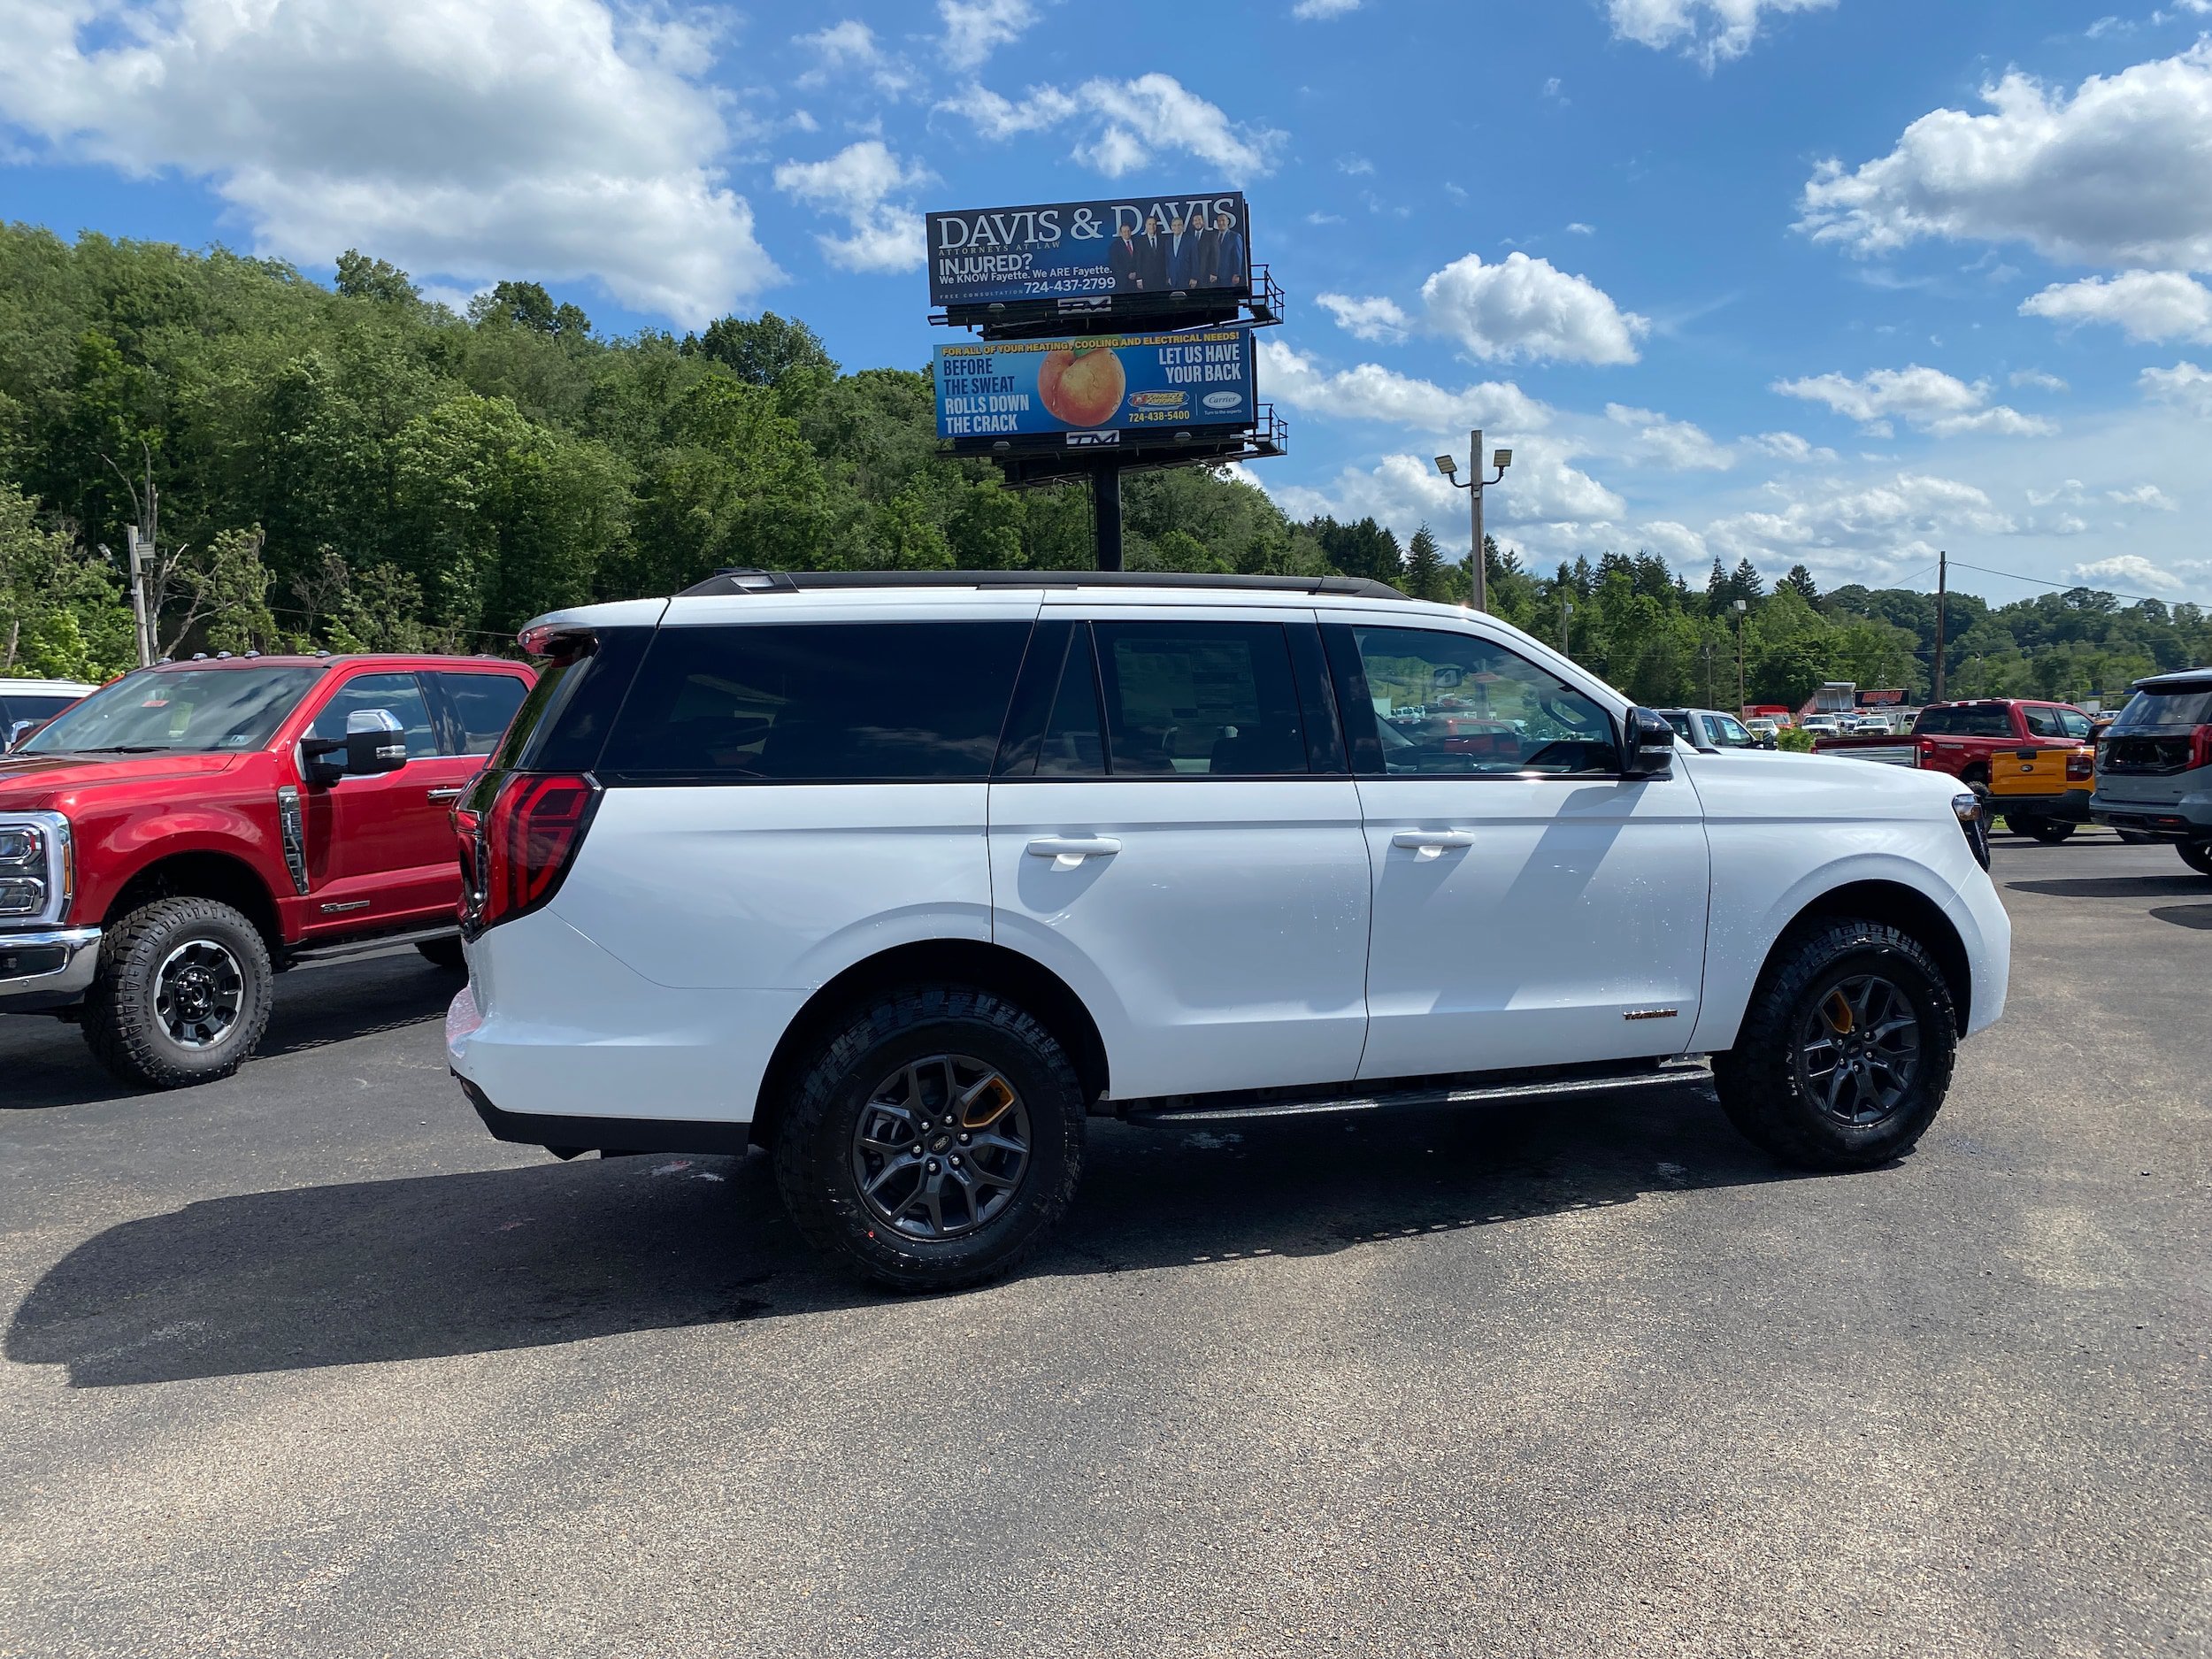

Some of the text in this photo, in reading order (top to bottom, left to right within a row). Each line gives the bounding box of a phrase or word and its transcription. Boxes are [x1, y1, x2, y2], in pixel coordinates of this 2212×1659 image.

[936, 197, 1236, 250] DAVIS & DAVIS
[939, 245, 1009, 257] ATTORNEYS
[1036, 242, 1060, 250] LAW
[939, 253, 1033, 275] INJURED?
[940, 265, 1113, 284] We KNOW Fayette. We ARE Fayette.
[1024, 276, 1116, 294] 724-437-2799
[942, 347, 963, 357] FOR
[964, 346, 982, 355] ALL
[983, 345, 997, 354] OF
[998, 343, 1026, 353] YOUR
[1074, 338, 1119, 349] COOLING
[1120, 336, 1141, 347] AND
[1143, 334, 1202, 345] ELECTRICAL
[1203, 331, 1240, 342] NEEDS!
[1158, 343, 1240, 365] LET US HAVE
[943, 358, 993, 376] BEFORE
[1165, 363, 1241, 384] YOUR BACK
[944, 376, 1015, 396] THE SWEAT
[945, 394, 1030, 415] ROLLS DOWN
[946, 413, 1018, 434] THE CRACK
[1128, 410, 1190, 423] 724-438-5400
